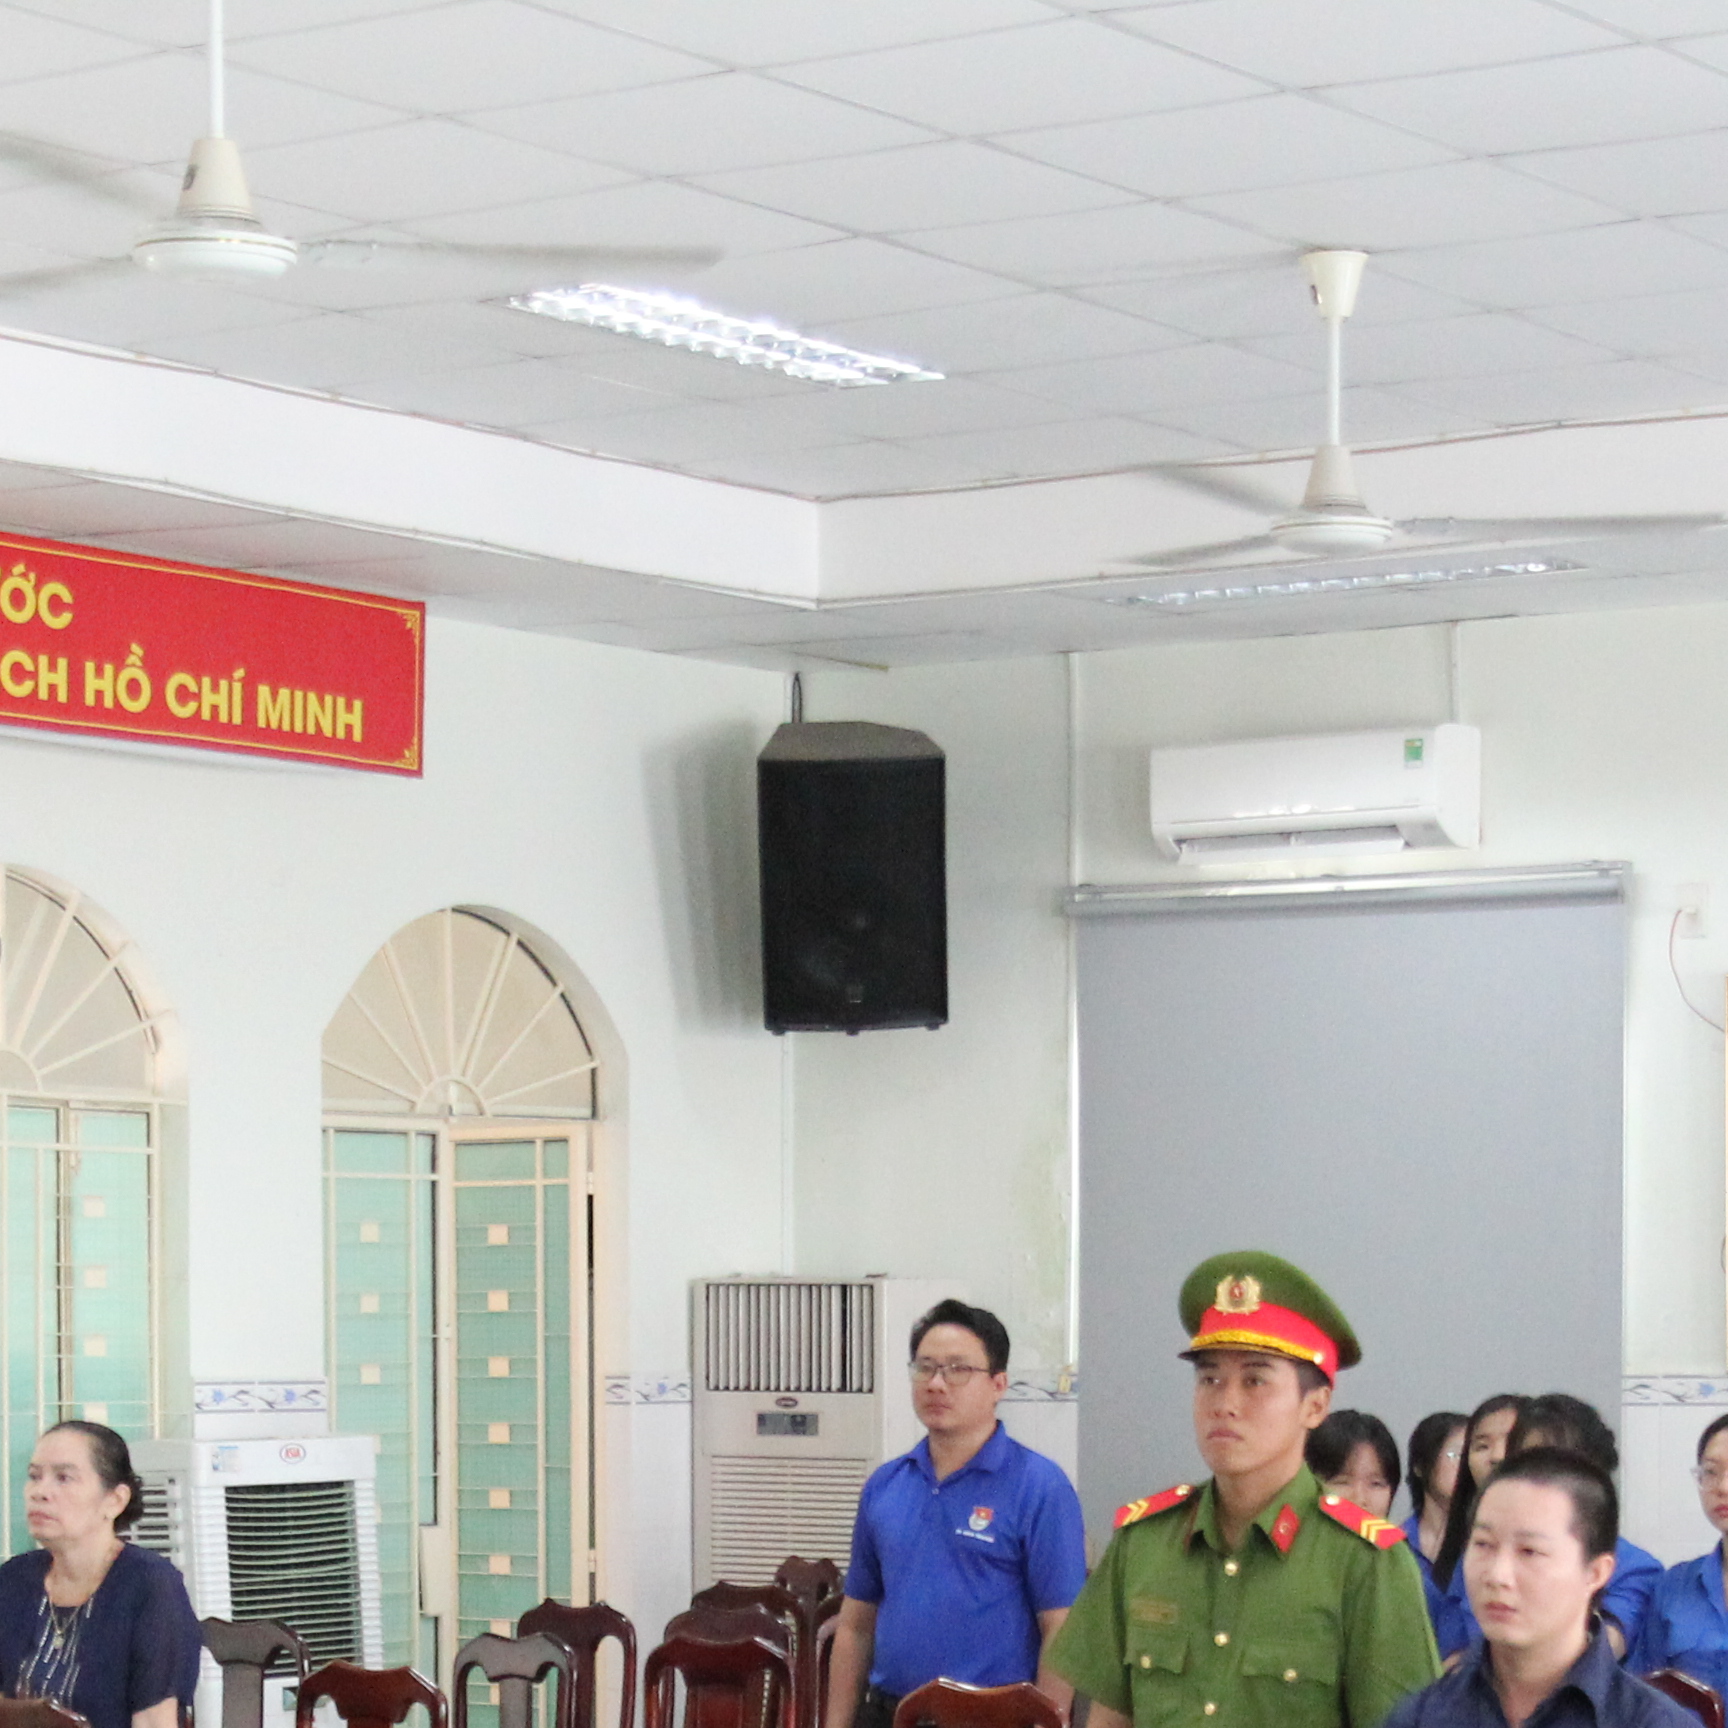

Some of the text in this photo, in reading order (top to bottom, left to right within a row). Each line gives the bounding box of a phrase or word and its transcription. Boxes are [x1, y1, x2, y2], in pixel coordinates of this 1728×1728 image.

[83, 641, 153, 714] HỒ
[163, 666, 246, 726] CHÍ
[255, 683, 364, 744] MINH
